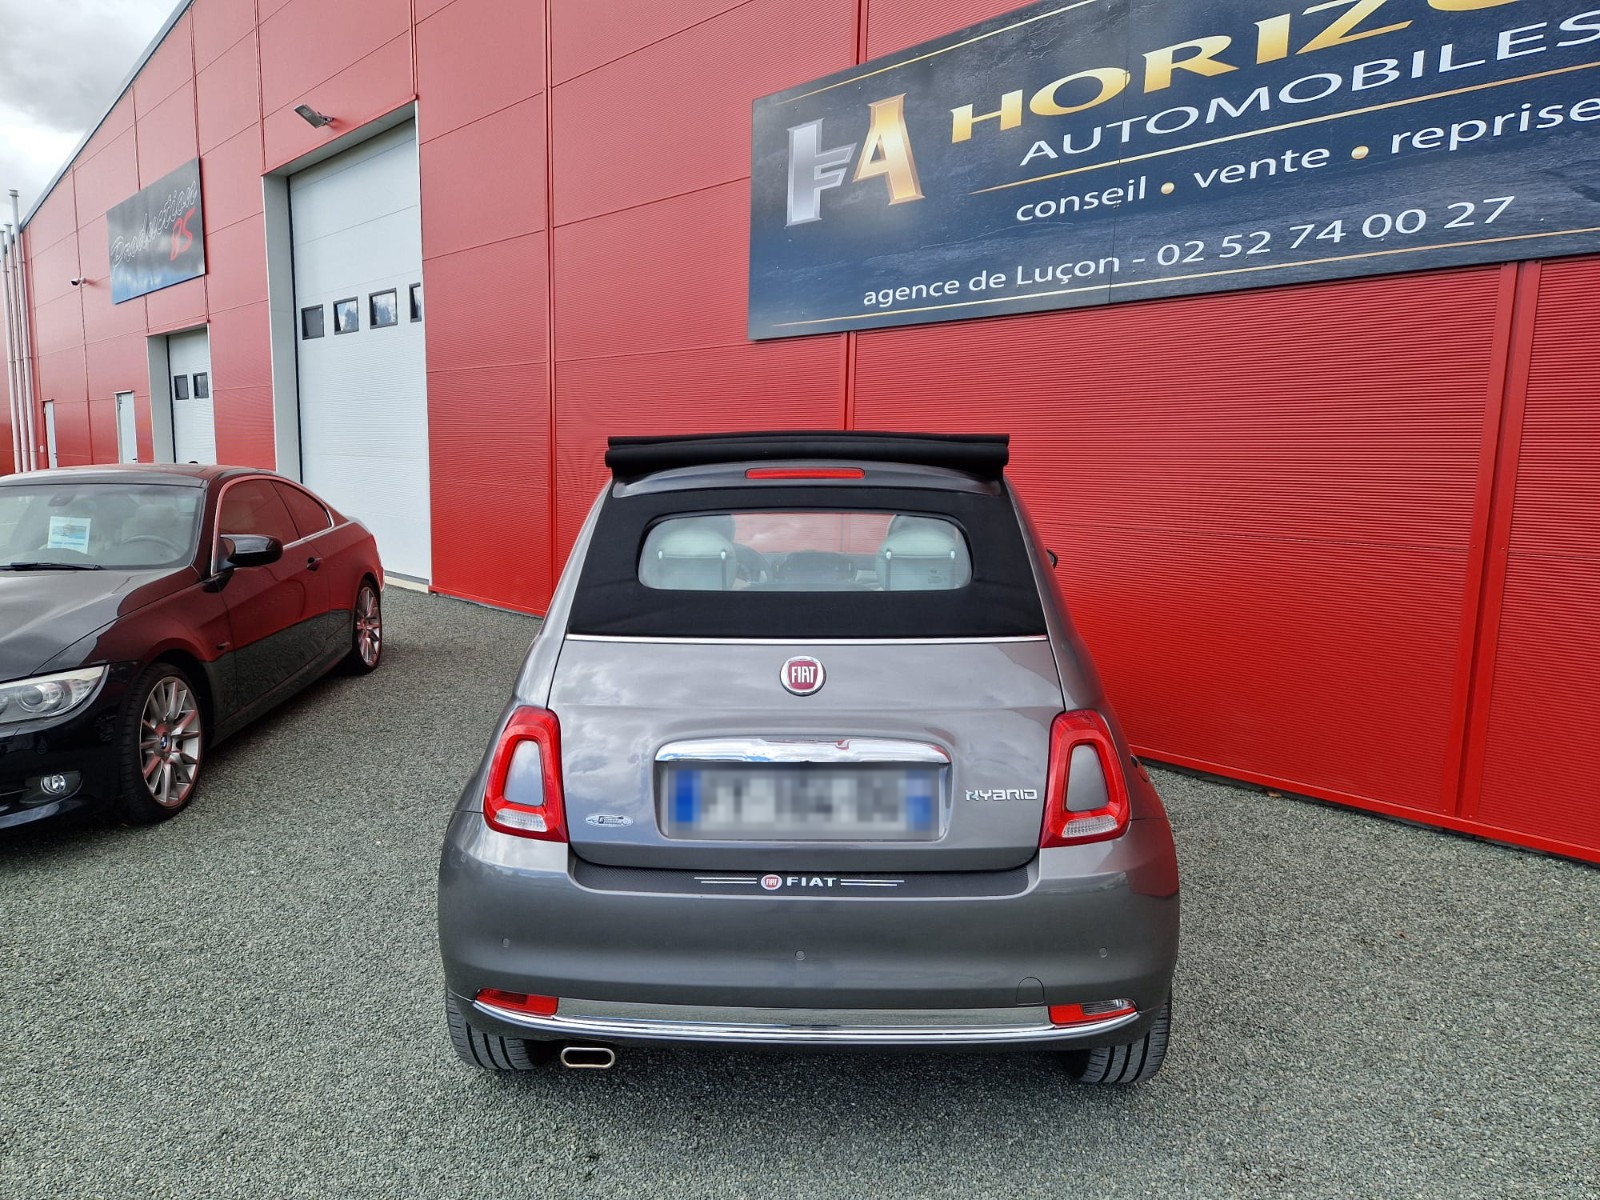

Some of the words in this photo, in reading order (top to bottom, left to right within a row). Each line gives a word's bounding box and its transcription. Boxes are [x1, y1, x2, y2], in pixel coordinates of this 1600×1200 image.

[950, 0, 1514, 144] HORIZ
[1020, 10, 1600, 167] AUTOMOBILES
[1016, 175, 1147, 222] conseil
[1193, 147, 1331, 188] vente
[863, 279, 960, 308] agence
[968, 270, 1006, 292] de
[1016, 256, 1120, 285] Luçon
[1157, 240, 1205, 267] 02
[1219, 231, 1272, 258] 52
[1289, 219, 1347, 249] 74
[1361, 209, 1427, 239] 00
[1443, 196, 1515, 229] 27
[791, 666, 816, 684] FIAT
[965, 788, 1038, 801] HYBRID
[786, 876, 838, 887] FIAT
